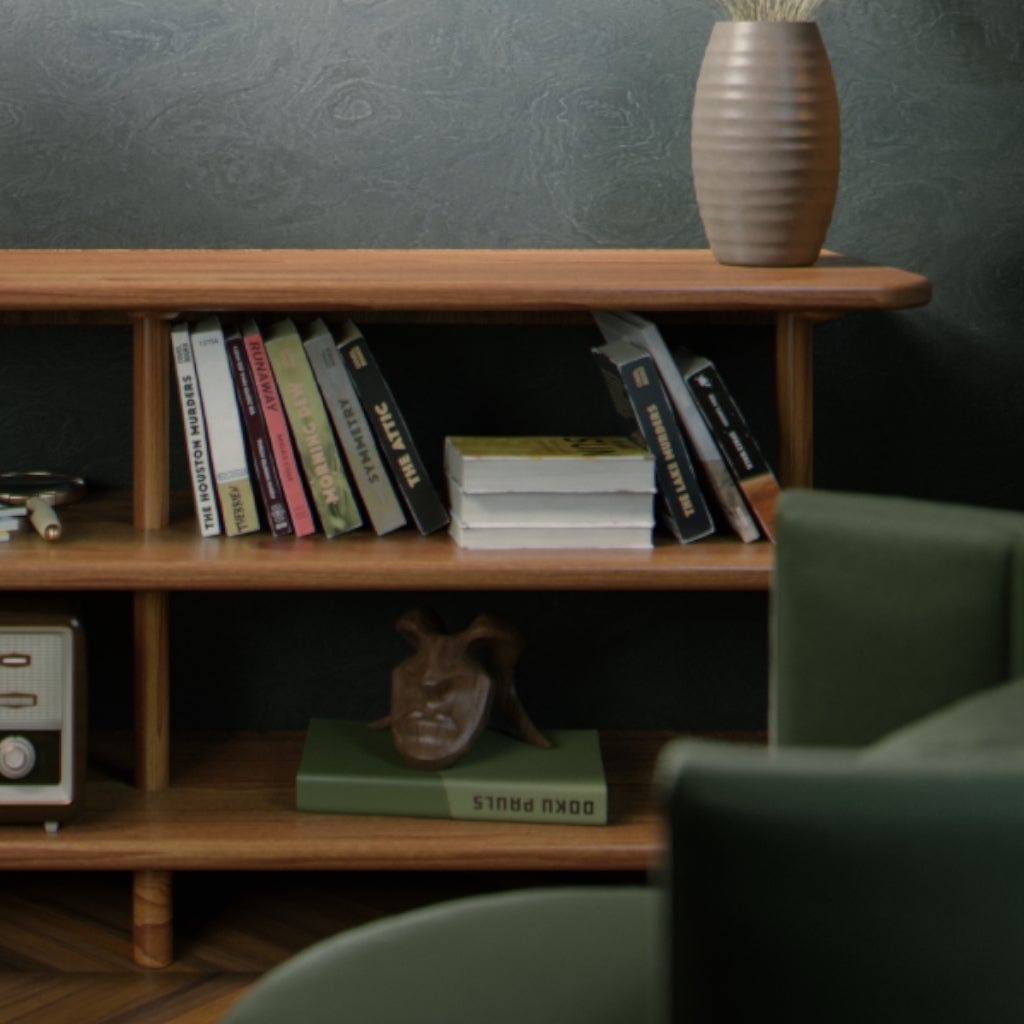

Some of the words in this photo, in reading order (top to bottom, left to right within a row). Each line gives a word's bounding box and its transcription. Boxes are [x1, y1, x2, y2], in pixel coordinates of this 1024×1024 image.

[249, 341, 279, 413] RUNAWAY
[182, 374, 201, 436] MURDERS
[287, 381, 313, 422] DEW
[338, 398, 378, 484] SYMMETRY
[374, 401, 406, 451] ATTIC
[646, 404, 675, 461] MURDERS
[192, 438, 212, 500] HOUSTON
[301, 422, 339, 504] MORNING
[395, 451, 421, 488] THE
[667, 461, 686, 493] LAKE
[203, 504, 214, 530] THE
[678, 494, 695, 519] THE
[473, 795, 534, 813] PAULS
[541, 797, 594, 815] DOKU
